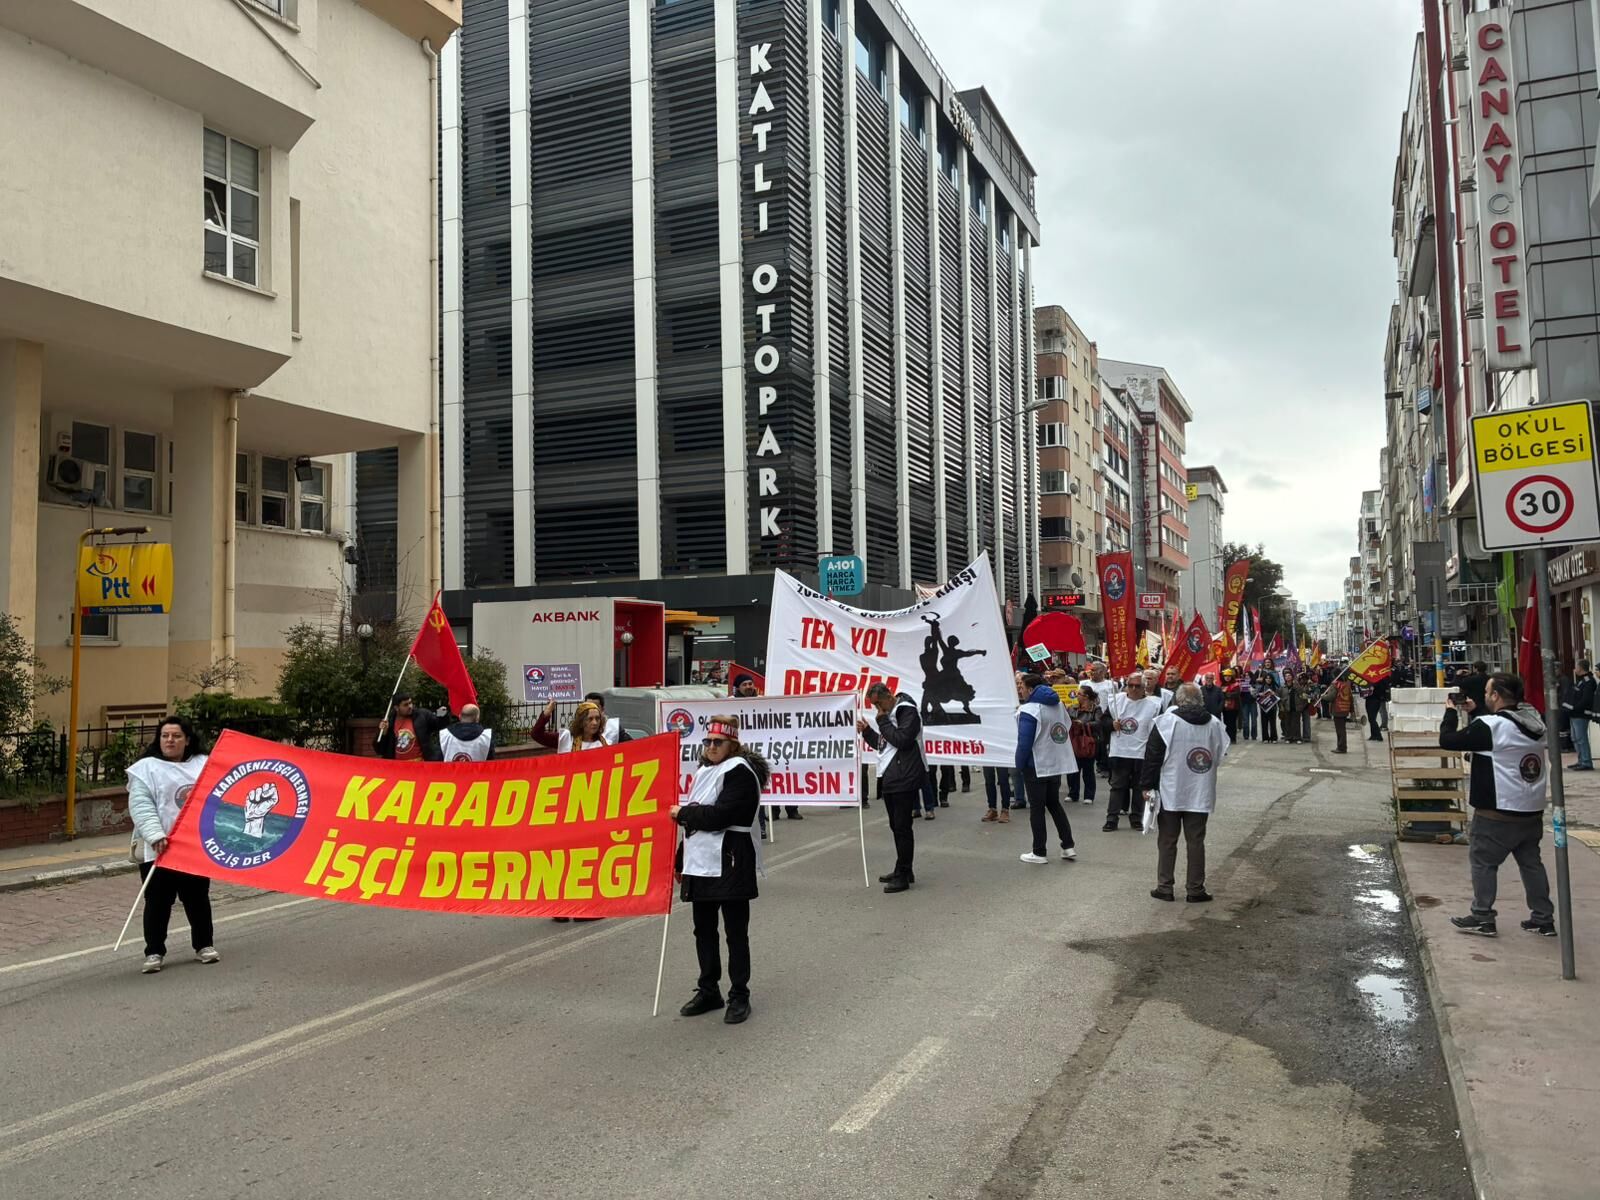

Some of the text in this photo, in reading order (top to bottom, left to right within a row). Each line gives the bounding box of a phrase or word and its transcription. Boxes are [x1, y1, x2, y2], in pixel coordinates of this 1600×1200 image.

[1478, 22, 1521, 354] CANAY OTEL
[748, 42, 782, 537] KATLI OTOPARK
[1498, 416, 1565, 438] OKUL
[1484, 433, 1585, 463] BÖLGESİ
[1519, 489, 1561, 517] 30
[102, 577, 130, 600] Ptt
[827, 571, 855, 579] HARCA
[827, 578, 855, 586] HARCA
[532, 610, 600, 623] AKBANK
[851, 626, 888, 658] YOL
[735, 707, 792, 730] İLİMİNE
[795, 709, 854, 729] TAKILAN
[767, 734, 855, 765] İŞÇİLERİNE
[925, 739, 985, 755] DERNEĞİ
[212, 760, 273, 798] KARADENİZ
[336, 753, 660, 827] KARADENİZ
[763, 765, 841, 795] ERİLSİN
[242, 851, 271, 866] DER
[304, 827, 654, 900] İŞÇİ DERNEĞİ
